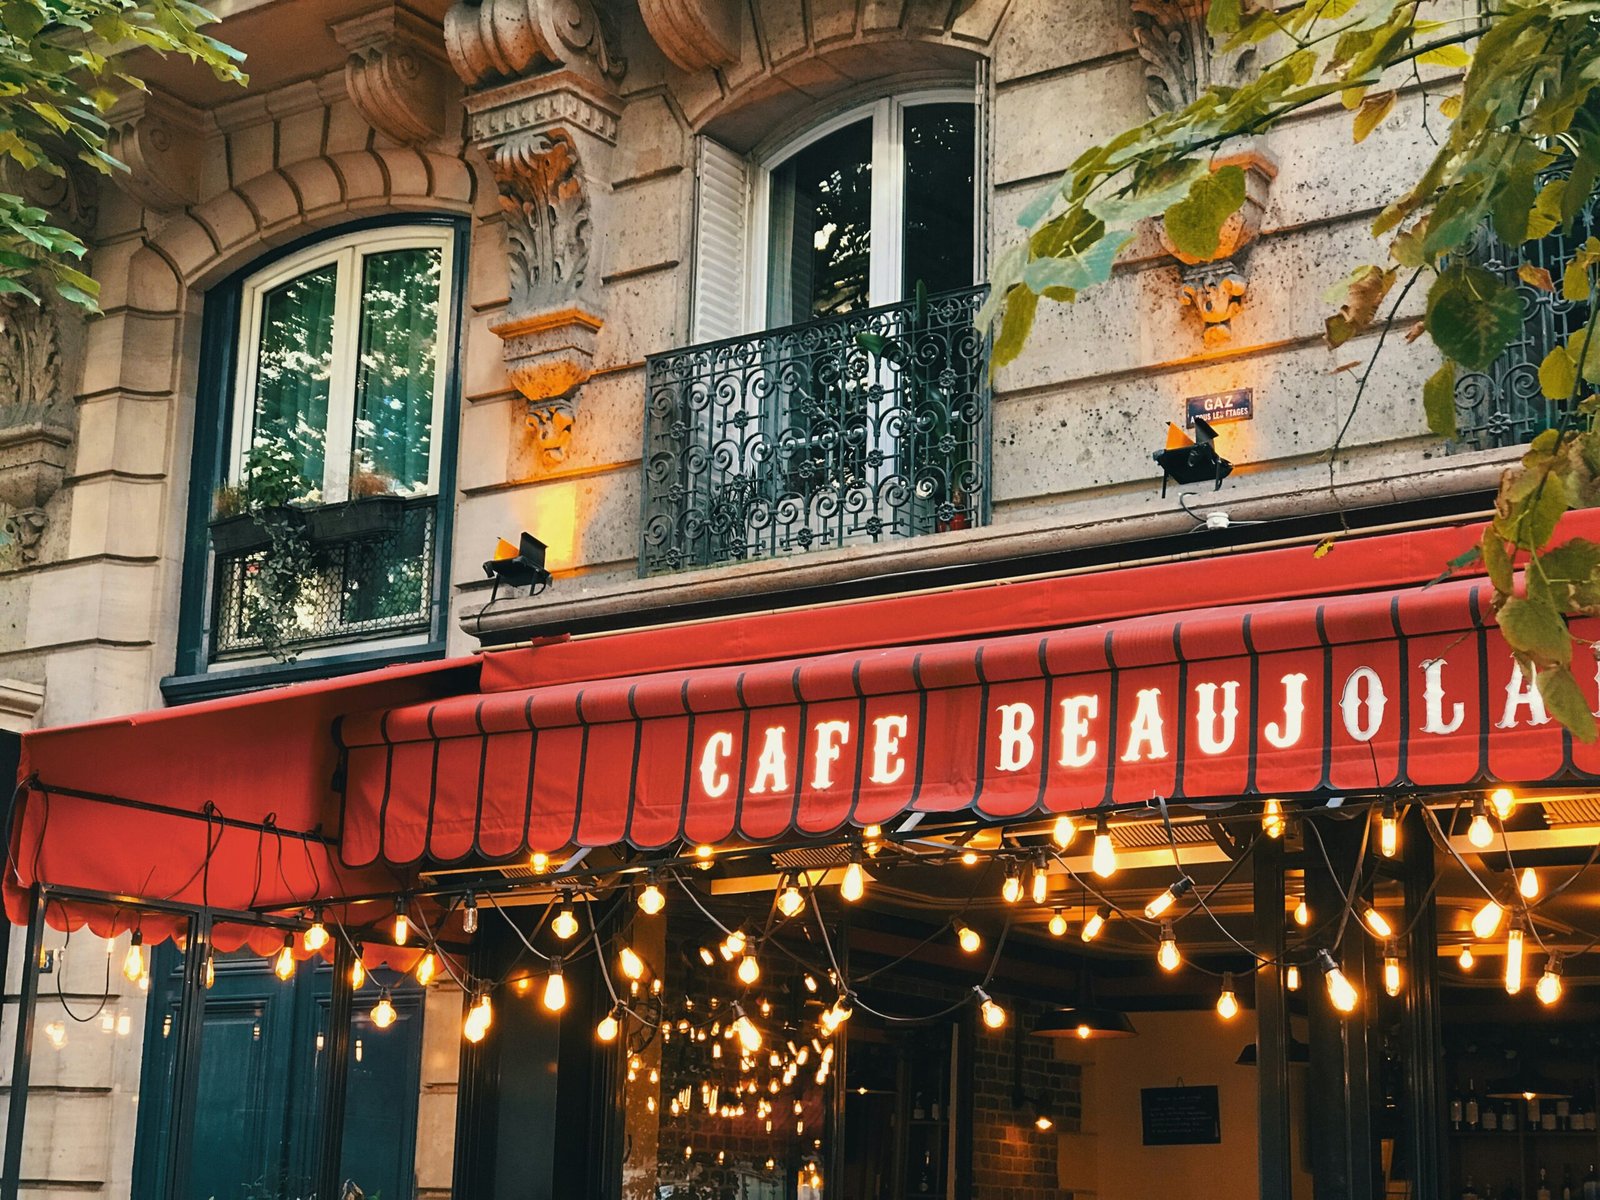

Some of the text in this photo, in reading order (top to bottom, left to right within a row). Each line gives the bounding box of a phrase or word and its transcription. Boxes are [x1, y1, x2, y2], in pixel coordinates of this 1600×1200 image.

[1204, 395, 1234, 411] GAZ
[698, 641, 1600, 799] CAFE BEAUJOLA
